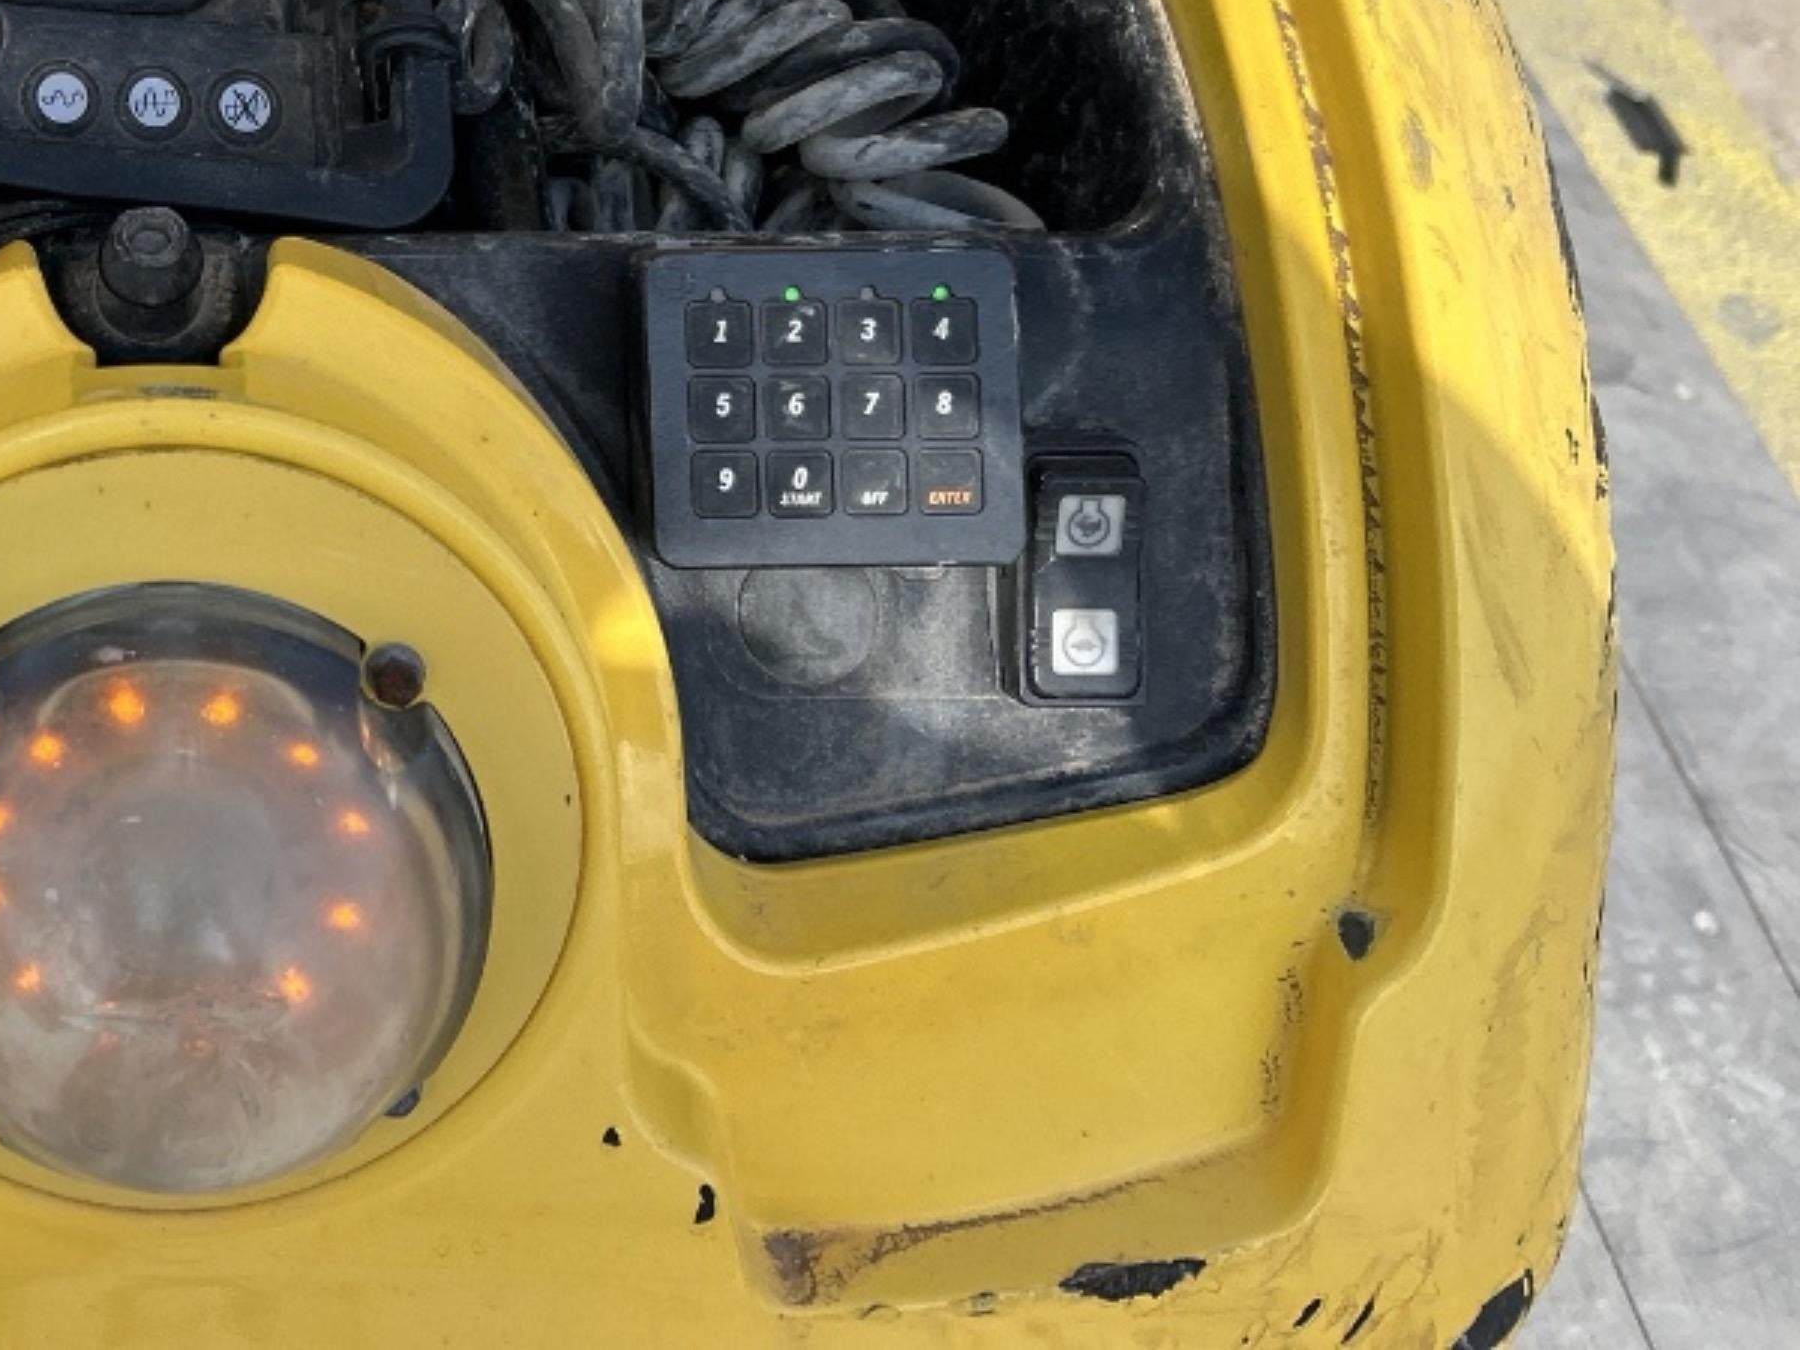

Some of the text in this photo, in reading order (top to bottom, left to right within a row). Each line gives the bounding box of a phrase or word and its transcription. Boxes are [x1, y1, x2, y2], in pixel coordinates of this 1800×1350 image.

[713, 319, 727, 343] 1
[786, 319, 802, 343] 2
[860, 317, 877, 341] 3
[933, 317, 950, 340] 4
[715, 393, 732, 418] 5
[788, 392, 805, 416] 6
[863, 392, 880, 415] 7
[935, 390, 953, 415] 8
[717, 467, 735, 492] 9
[792, 466, 809, 490] 0
[928, 491, 973, 506] ENTER
